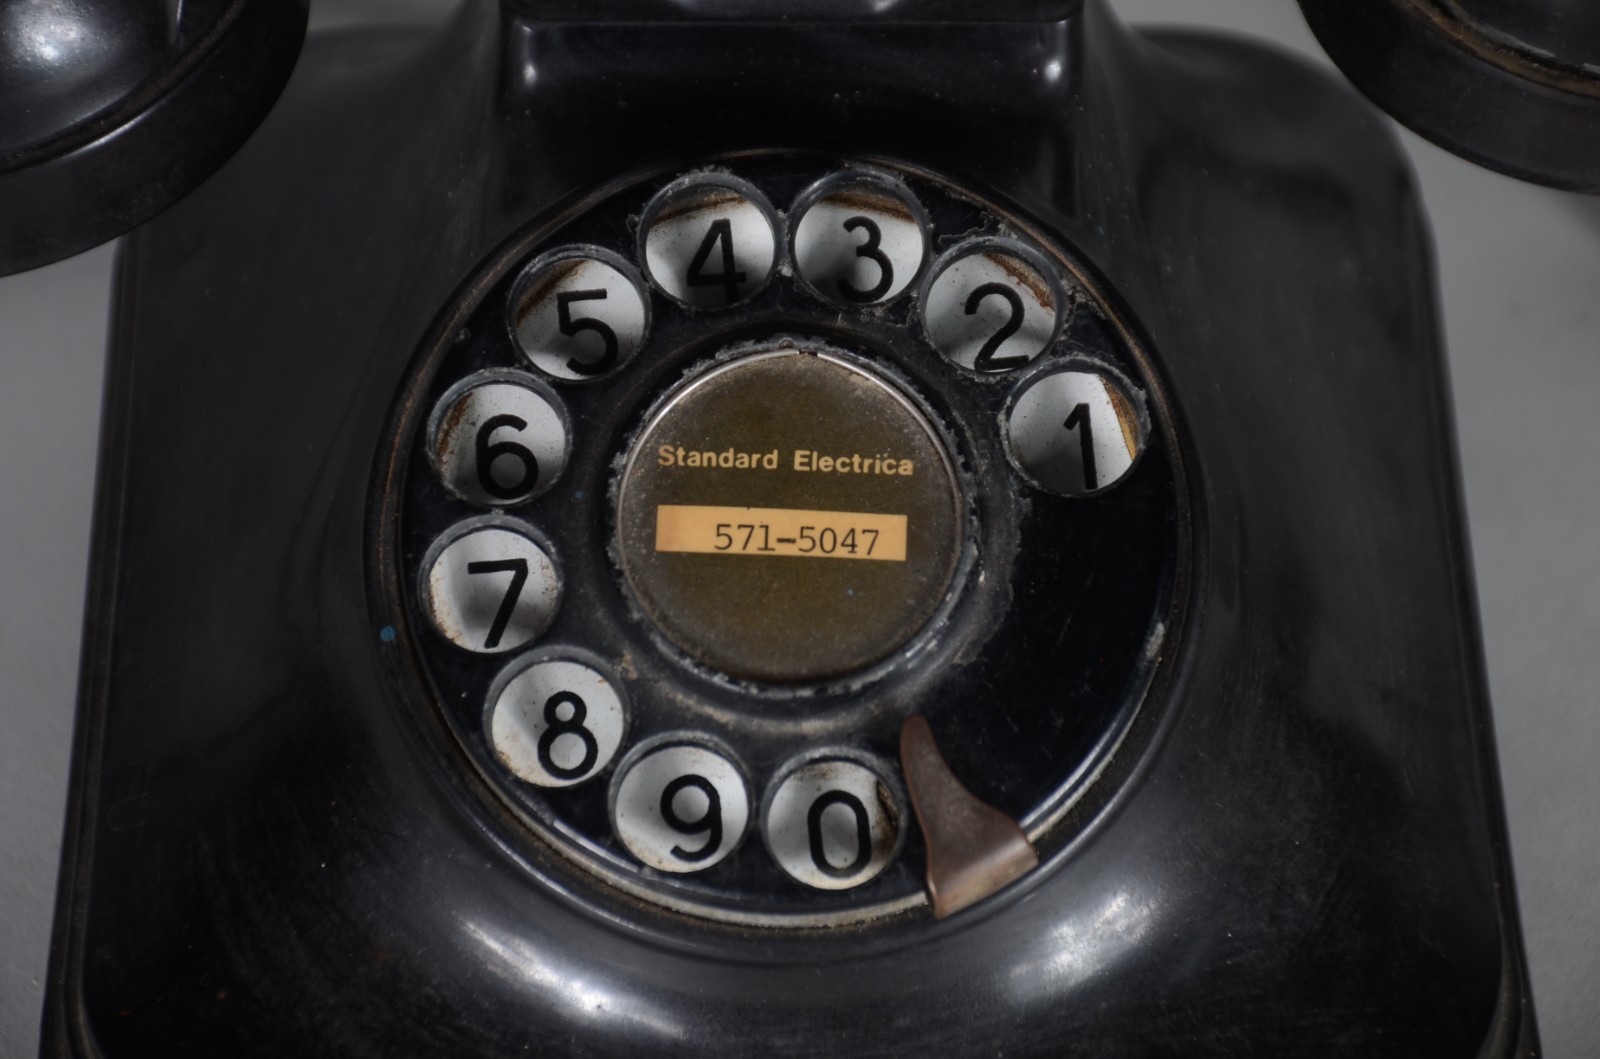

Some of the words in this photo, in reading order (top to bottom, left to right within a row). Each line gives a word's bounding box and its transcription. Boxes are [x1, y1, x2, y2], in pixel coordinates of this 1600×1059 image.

[686, 218, 747, 303] 4
[836, 215, 894, 303] 3
[556, 288, 619, 376] 5
[964, 282, 1030, 371] 2
[475, 414, 539, 500] 6
[657, 445, 778, 469] Standard
[794, 450, 914, 475] Electrica
[1063, 403, 1098, 490] 1
[714, 523, 880, 556] 571-5047
[467, 558, 529, 648] 7
[537, 690, 599, 780] 8
[660, 774, 723, 862] 9
[807, 789, 872, 878] 0
